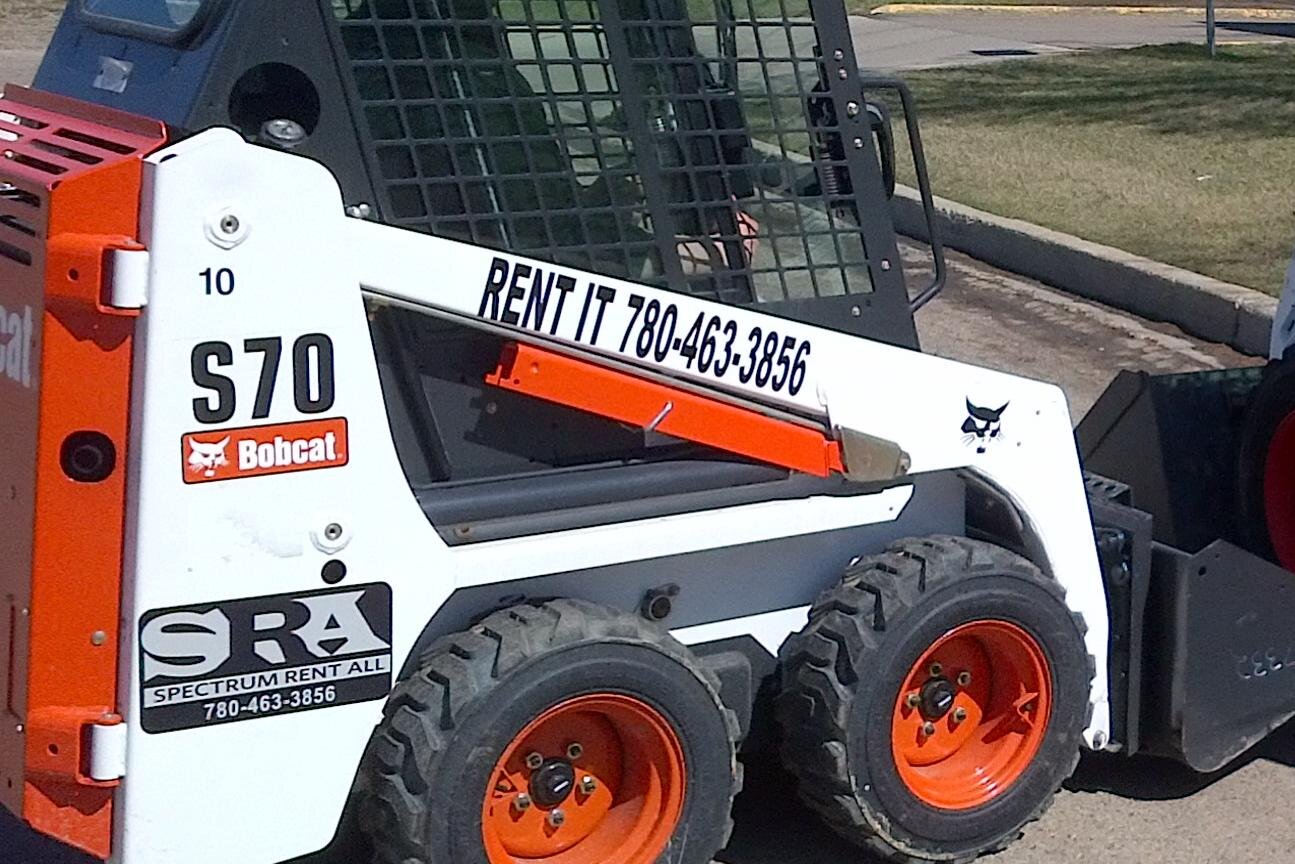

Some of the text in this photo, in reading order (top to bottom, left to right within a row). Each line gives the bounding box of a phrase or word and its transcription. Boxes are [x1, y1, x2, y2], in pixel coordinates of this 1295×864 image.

[198, 267, 235, 296] 10
[478, 256, 811, 397] RENT IT 780-463-3856
[190, 332, 336, 424] S70
[237, 431, 337, 471] Bobcat
[140, 589, 392, 684] SRA
[153, 657, 386, 703] SPECTRUM RENT ALL
[203, 685, 337, 721] 780-463-3856
